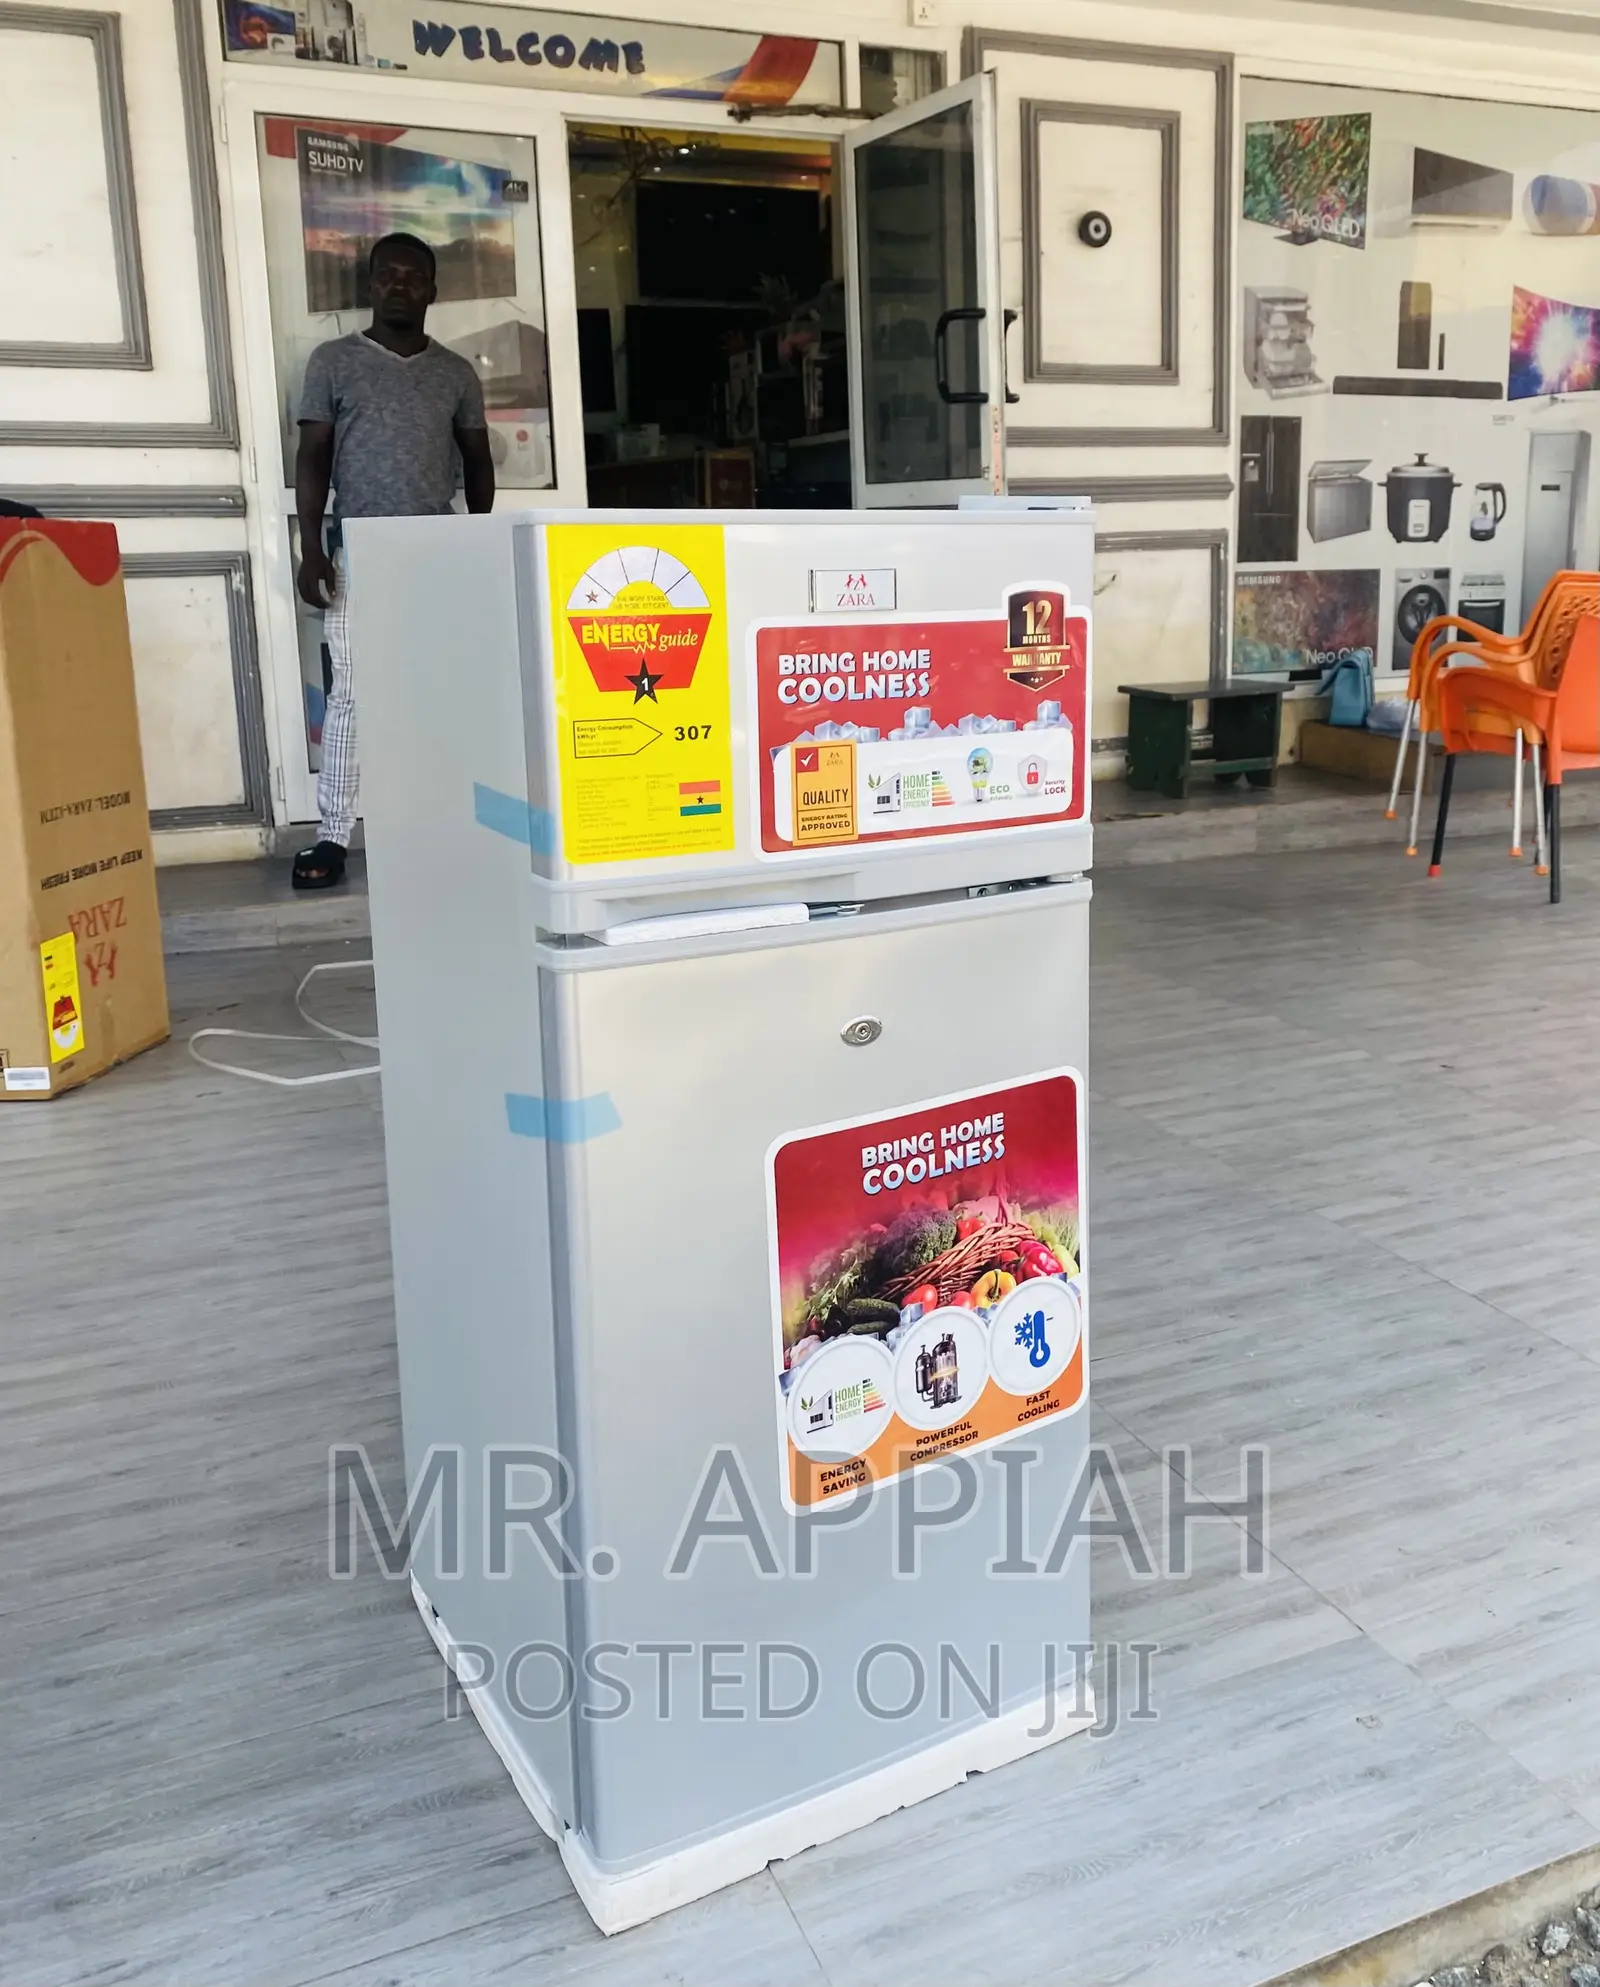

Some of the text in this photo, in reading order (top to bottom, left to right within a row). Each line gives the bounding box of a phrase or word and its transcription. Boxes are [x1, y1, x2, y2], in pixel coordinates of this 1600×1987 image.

[412, 19, 646, 75] WELCOME
[505, 181, 523, 194] 4K
[1289, 208, 1360, 239] Neo QLED
[1237, 575, 1282, 586] SAMSUNG
[836, 592, 876, 607] ZARA
[1022, 599, 1052, 635] 12
[581, 619, 699, 652] ENERGY guide
[1022, 635, 1051, 645] MONTHS
[778, 649, 932, 676] BRING HOME
[1304, 648, 1336, 664] Neo
[641, 677, 649, 691] 1
[777, 671, 931, 704] COOLNESS
[674, 725, 712, 742] 307
[903, 773, 931, 789] HOME
[989, 784, 1010, 795] ECO
[1044, 786, 1067, 795] LOCK
[803, 788, 849, 806] QUALITY
[903, 788, 930, 800] ENERGY
[800, 820, 851, 832] APPROVED
[801, 813, 848, 823] ENERGY RATING
[40, 848, 143, 891] KEEP LIFE MORE FRESH
[67, 896, 128, 945] ZARA
[861, 1112, 1005, 1169] BRING HOME
[862, 1134, 1006, 1196] COOLNESS
[834, 1383, 862, 1403] HOME
[1025, 1390, 1051, 1407] FAST
[835, 1396, 862, 1414] ENERGY
[1017, 1399, 1060, 1423] COOLING
[915, 1420, 973, 1448] POWERFUL
[909, 1429, 979, 1462] COMPRESSOR
[819, 1458, 867, 1483] ENERGY
[822, 1472, 867, 1495] SAVING
